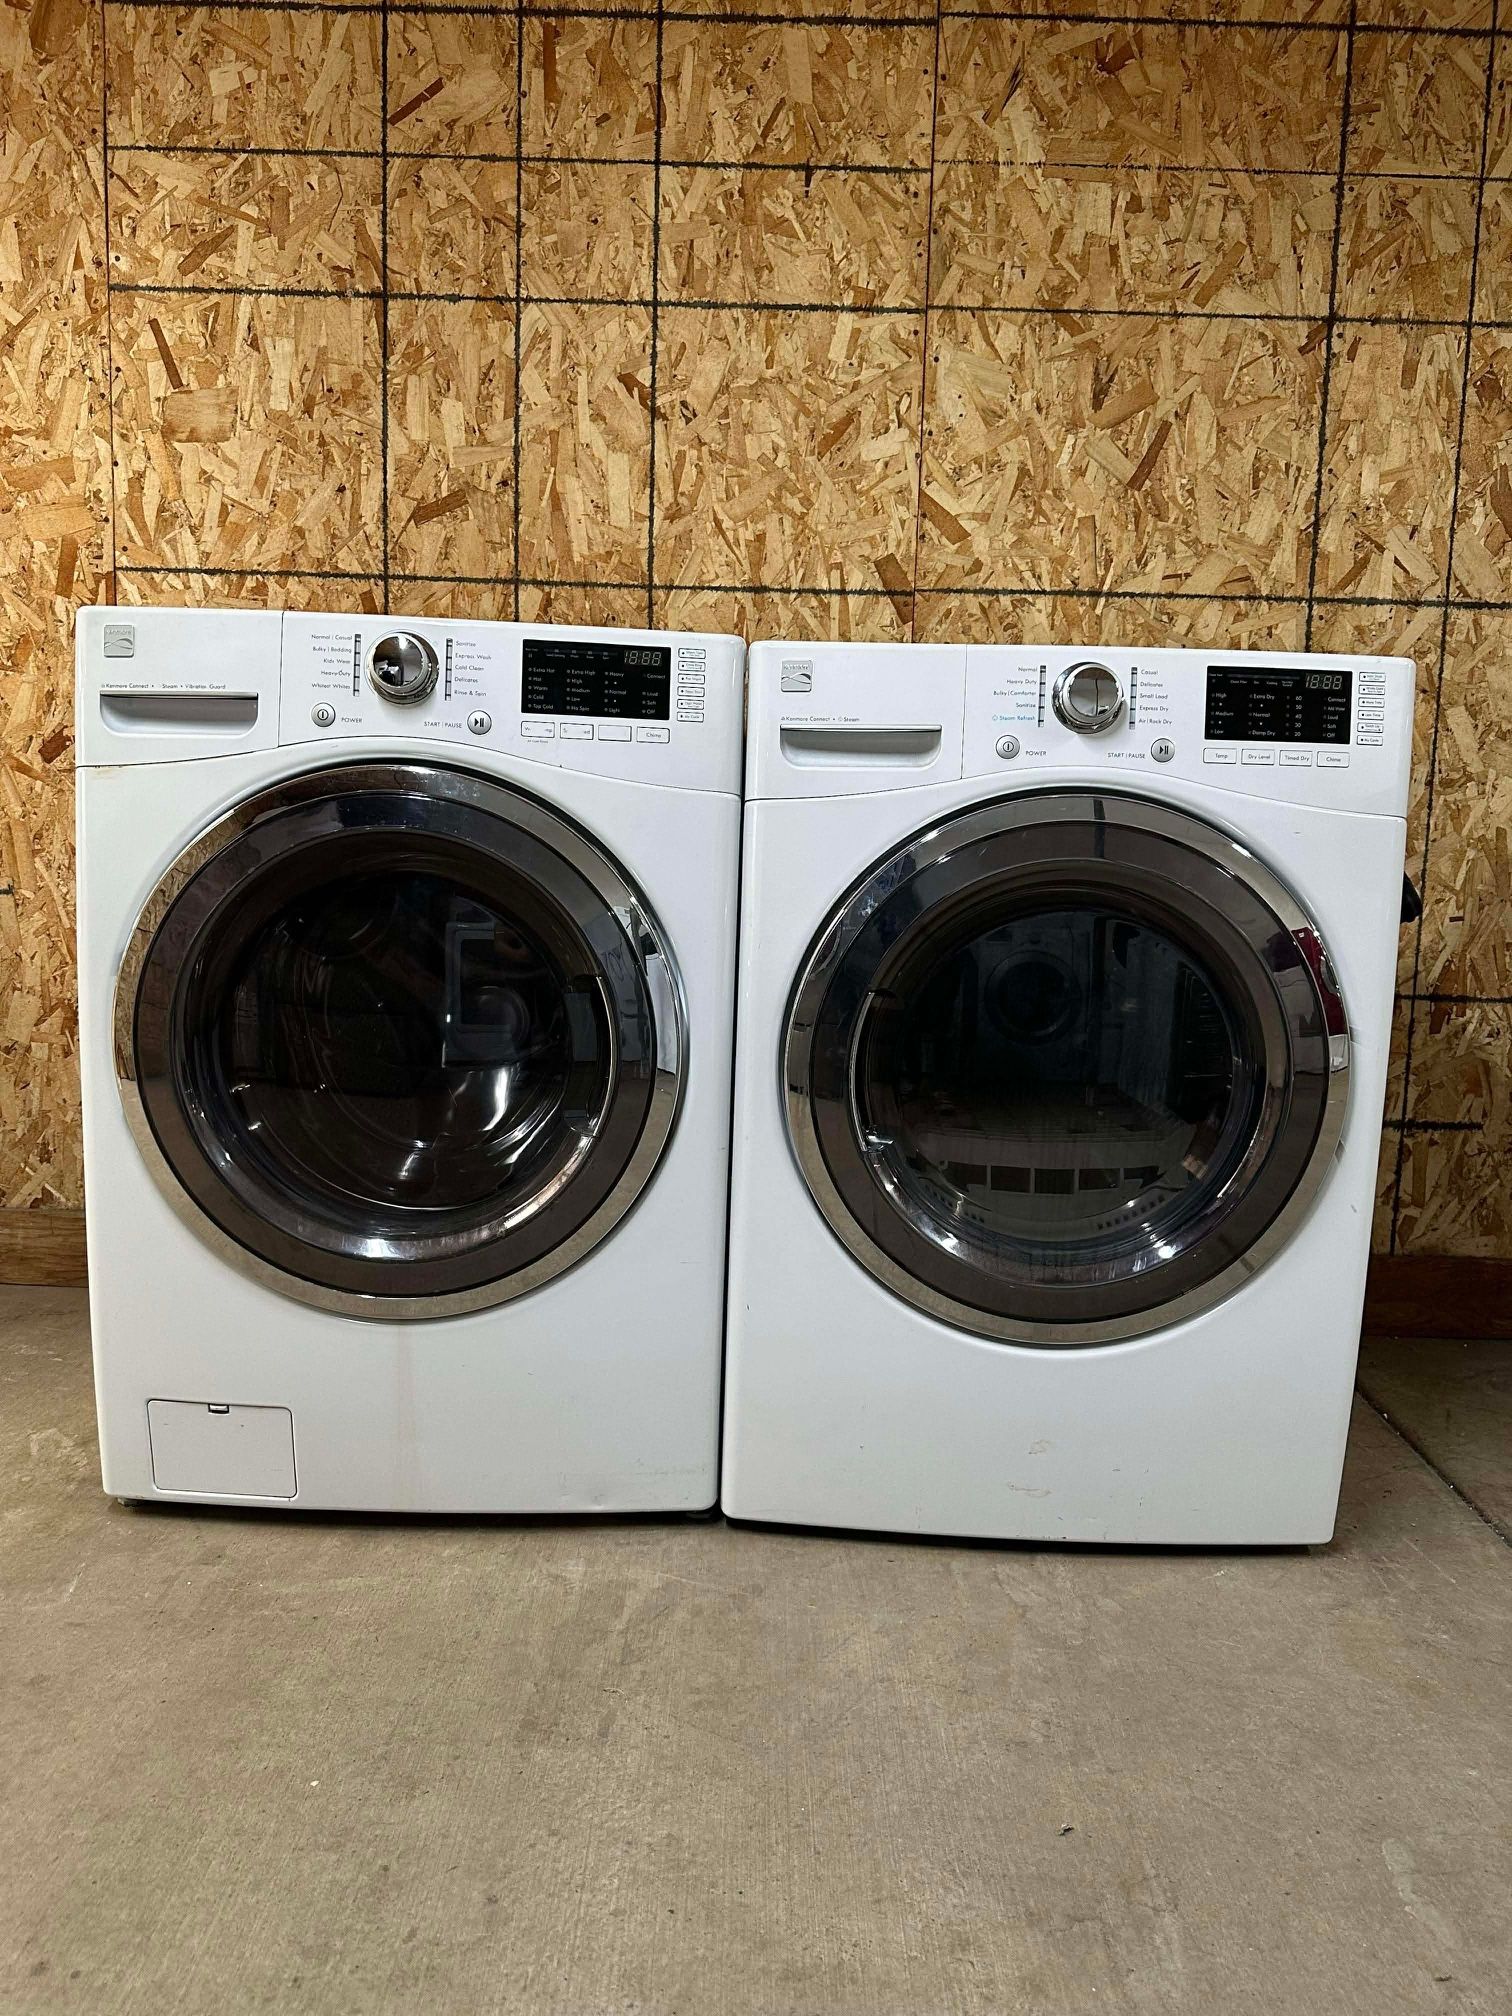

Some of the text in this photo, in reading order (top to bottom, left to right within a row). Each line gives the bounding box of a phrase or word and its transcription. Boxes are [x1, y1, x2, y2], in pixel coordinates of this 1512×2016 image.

[1215, 692, 1227, 700] High
[1266, 694, 1275, 702] Dry
[1139, 705, 1169, 714] Express Dry
[1266, 731, 1276, 739] Dry
[1248, 753, 1257, 761] Dry
